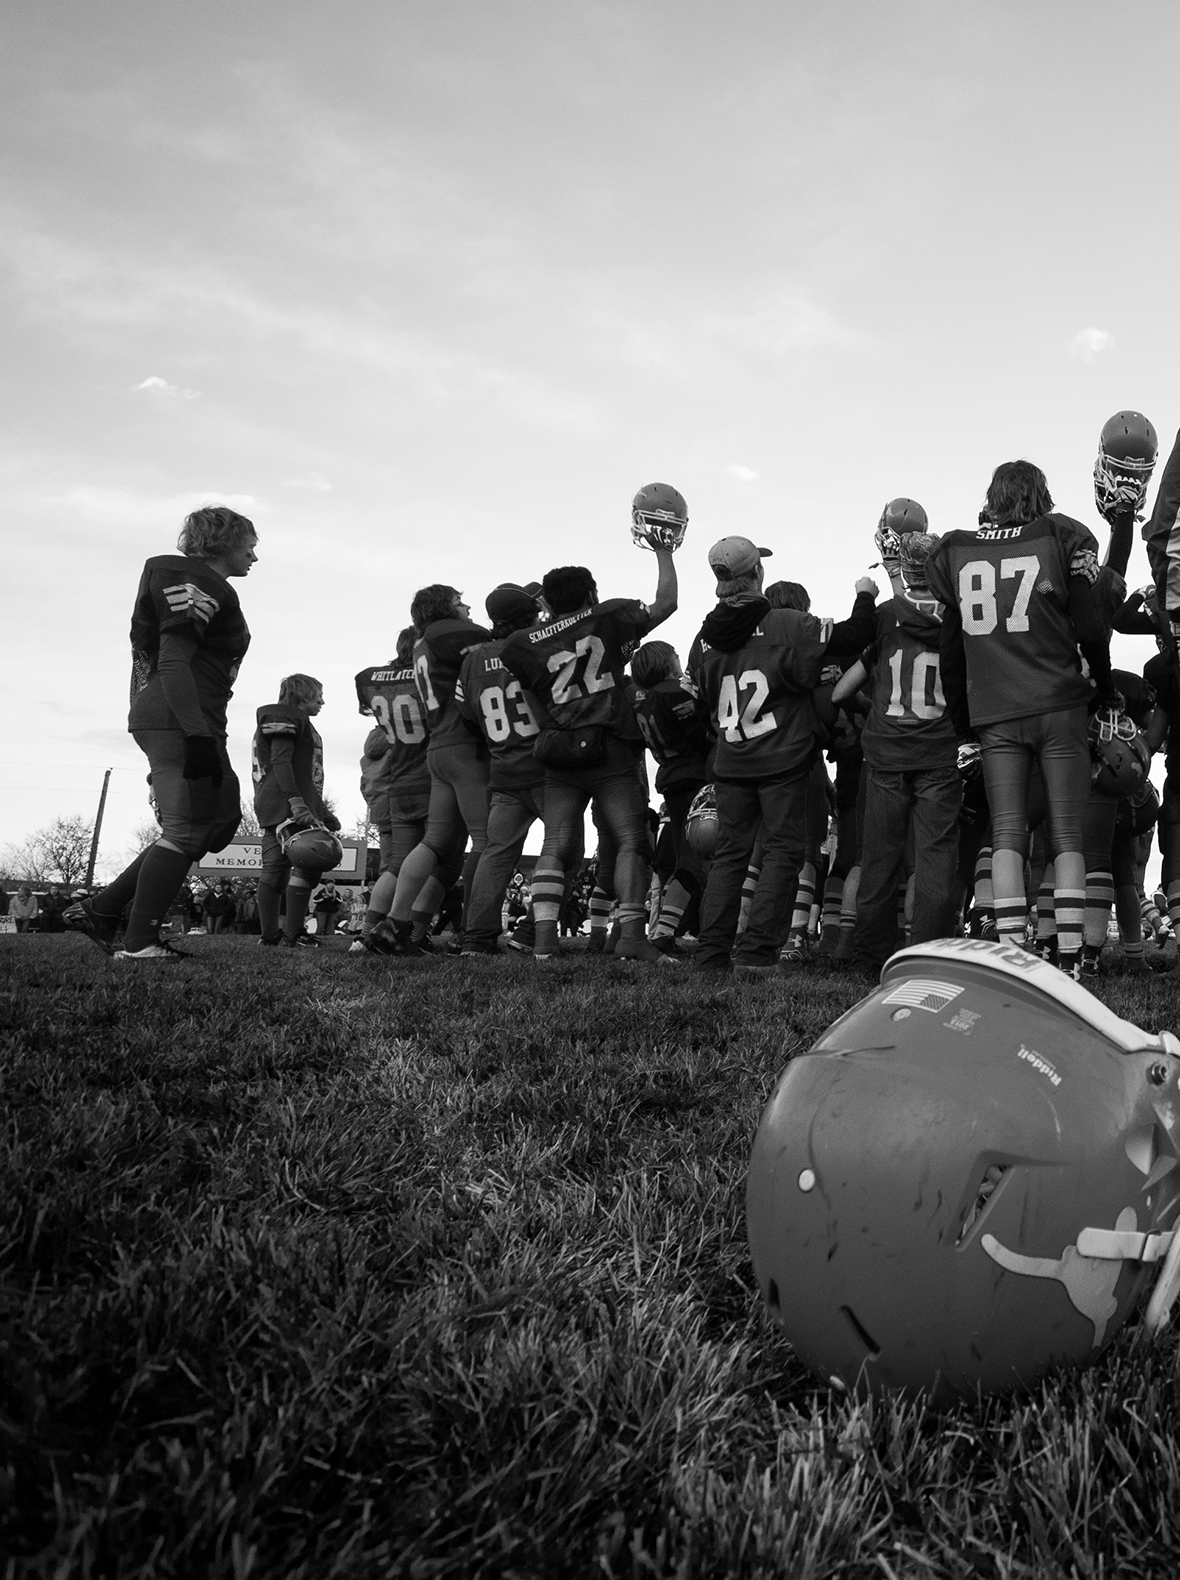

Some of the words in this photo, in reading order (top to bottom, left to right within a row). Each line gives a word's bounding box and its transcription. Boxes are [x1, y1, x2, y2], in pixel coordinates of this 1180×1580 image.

[976, 526, 1024, 540] SMITH
[958, 555, 1041, 636] 87
[546, 634, 616, 705] 22
[884, 648, 947, 720] 10
[371, 693, 426, 745] 30
[479, 680, 541, 743] 83
[718, 668, 778, 744] 42
[215, 857, 264, 867] MEMOR
[1017, 1047, 1062, 1086] Riddell
